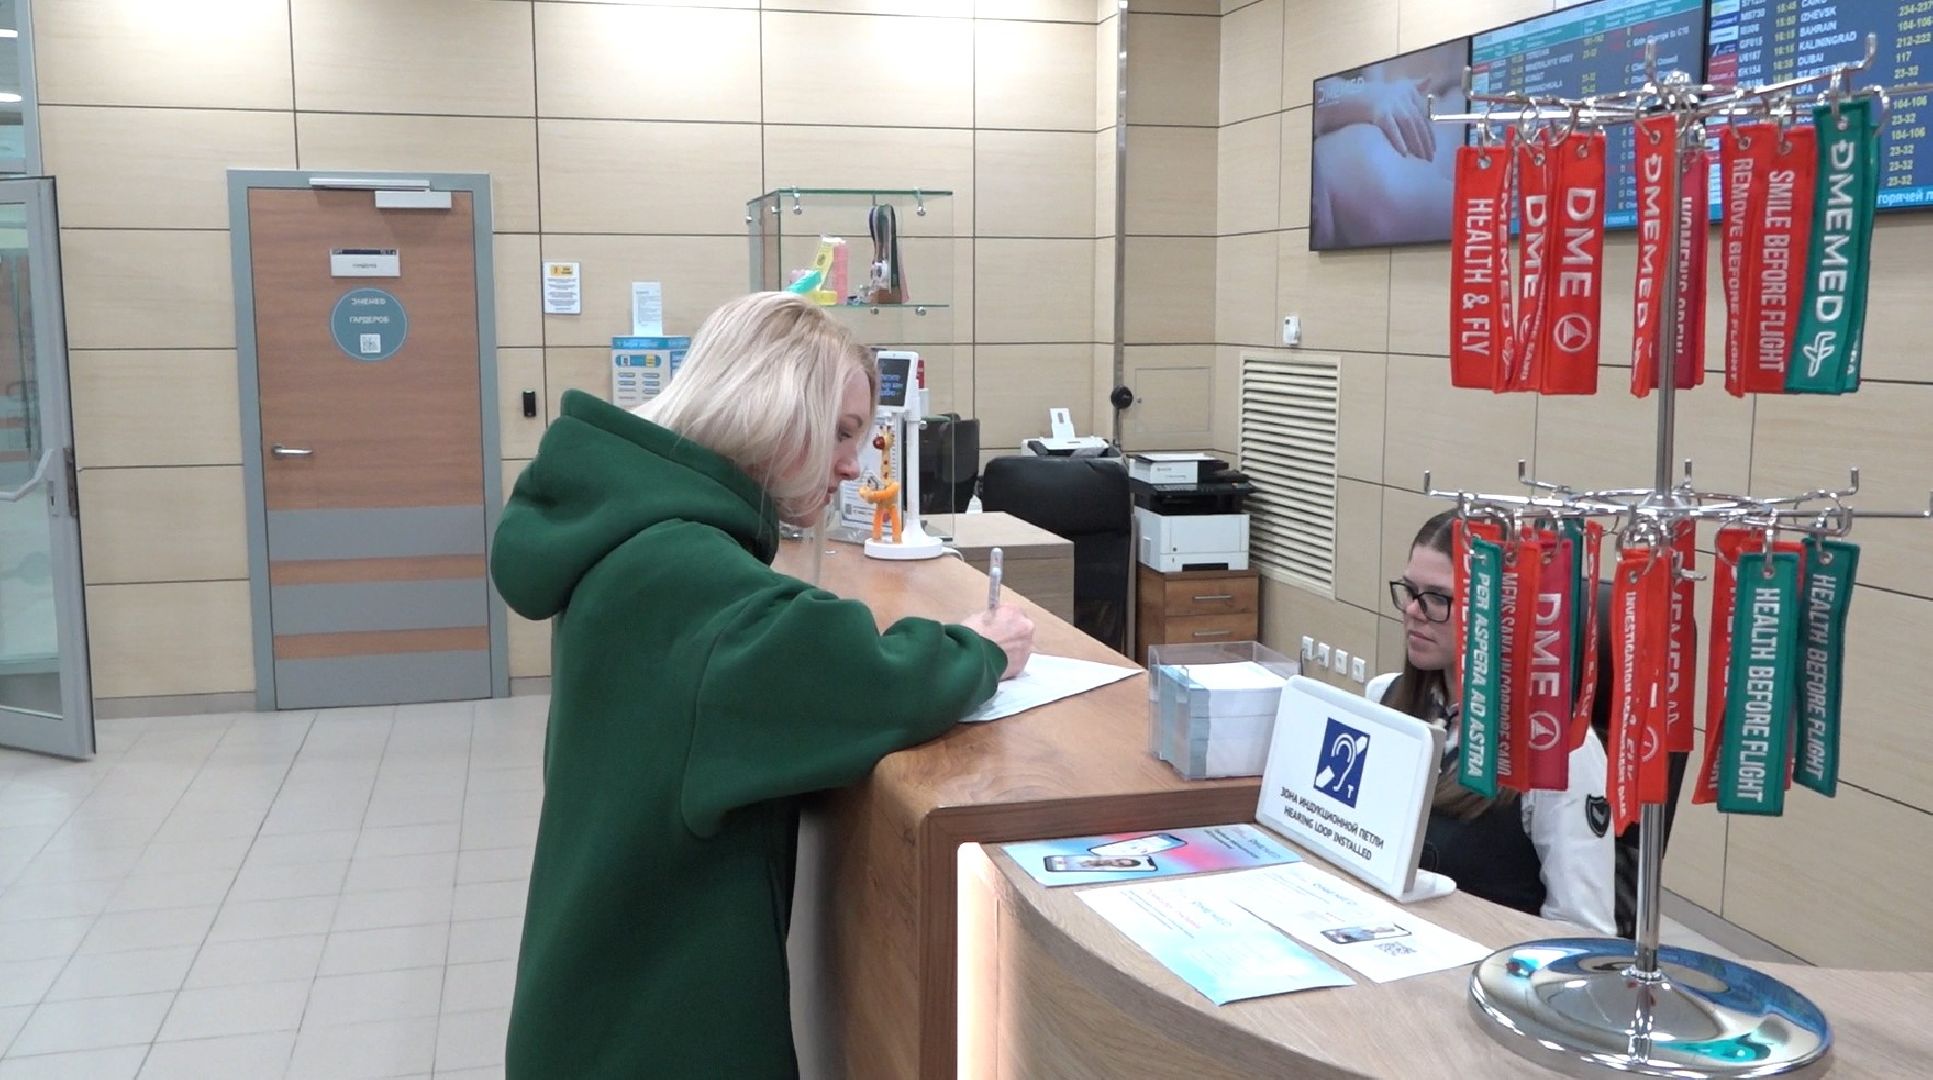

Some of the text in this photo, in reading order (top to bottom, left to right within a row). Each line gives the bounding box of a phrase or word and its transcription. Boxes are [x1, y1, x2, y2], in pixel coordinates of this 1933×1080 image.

[1797, 53, 1824, 66] DUBAI
[1523, 195, 1548, 299] DME
[1560, 187, 1597, 298] DME
[1637, 154, 1662, 328] DMEMED
[1730, 158, 1754, 237] REMOVE
[1815, 142, 1854, 321] DMEMED
[1462, 198, 1494, 356] HEALTH & FLY
[1758, 169, 1795, 373] SMILE BEFORE FLIGHT
[1467, 572, 1491, 777] PER ASPERA AD ASTRA
[1528, 593, 1563, 697] DME
[1736, 587, 1780, 803] HEALTH BEFORE FLIGHT
[1805, 573, 1836, 781] HEALTH BEFORE FLIGHT
[1280, 786, 1384, 850] ЗОНА ИНДУКЦИОННОЙ ПЕТЛИ
[1283, 806, 1372, 861] HEARING LOOP INSTALLED
